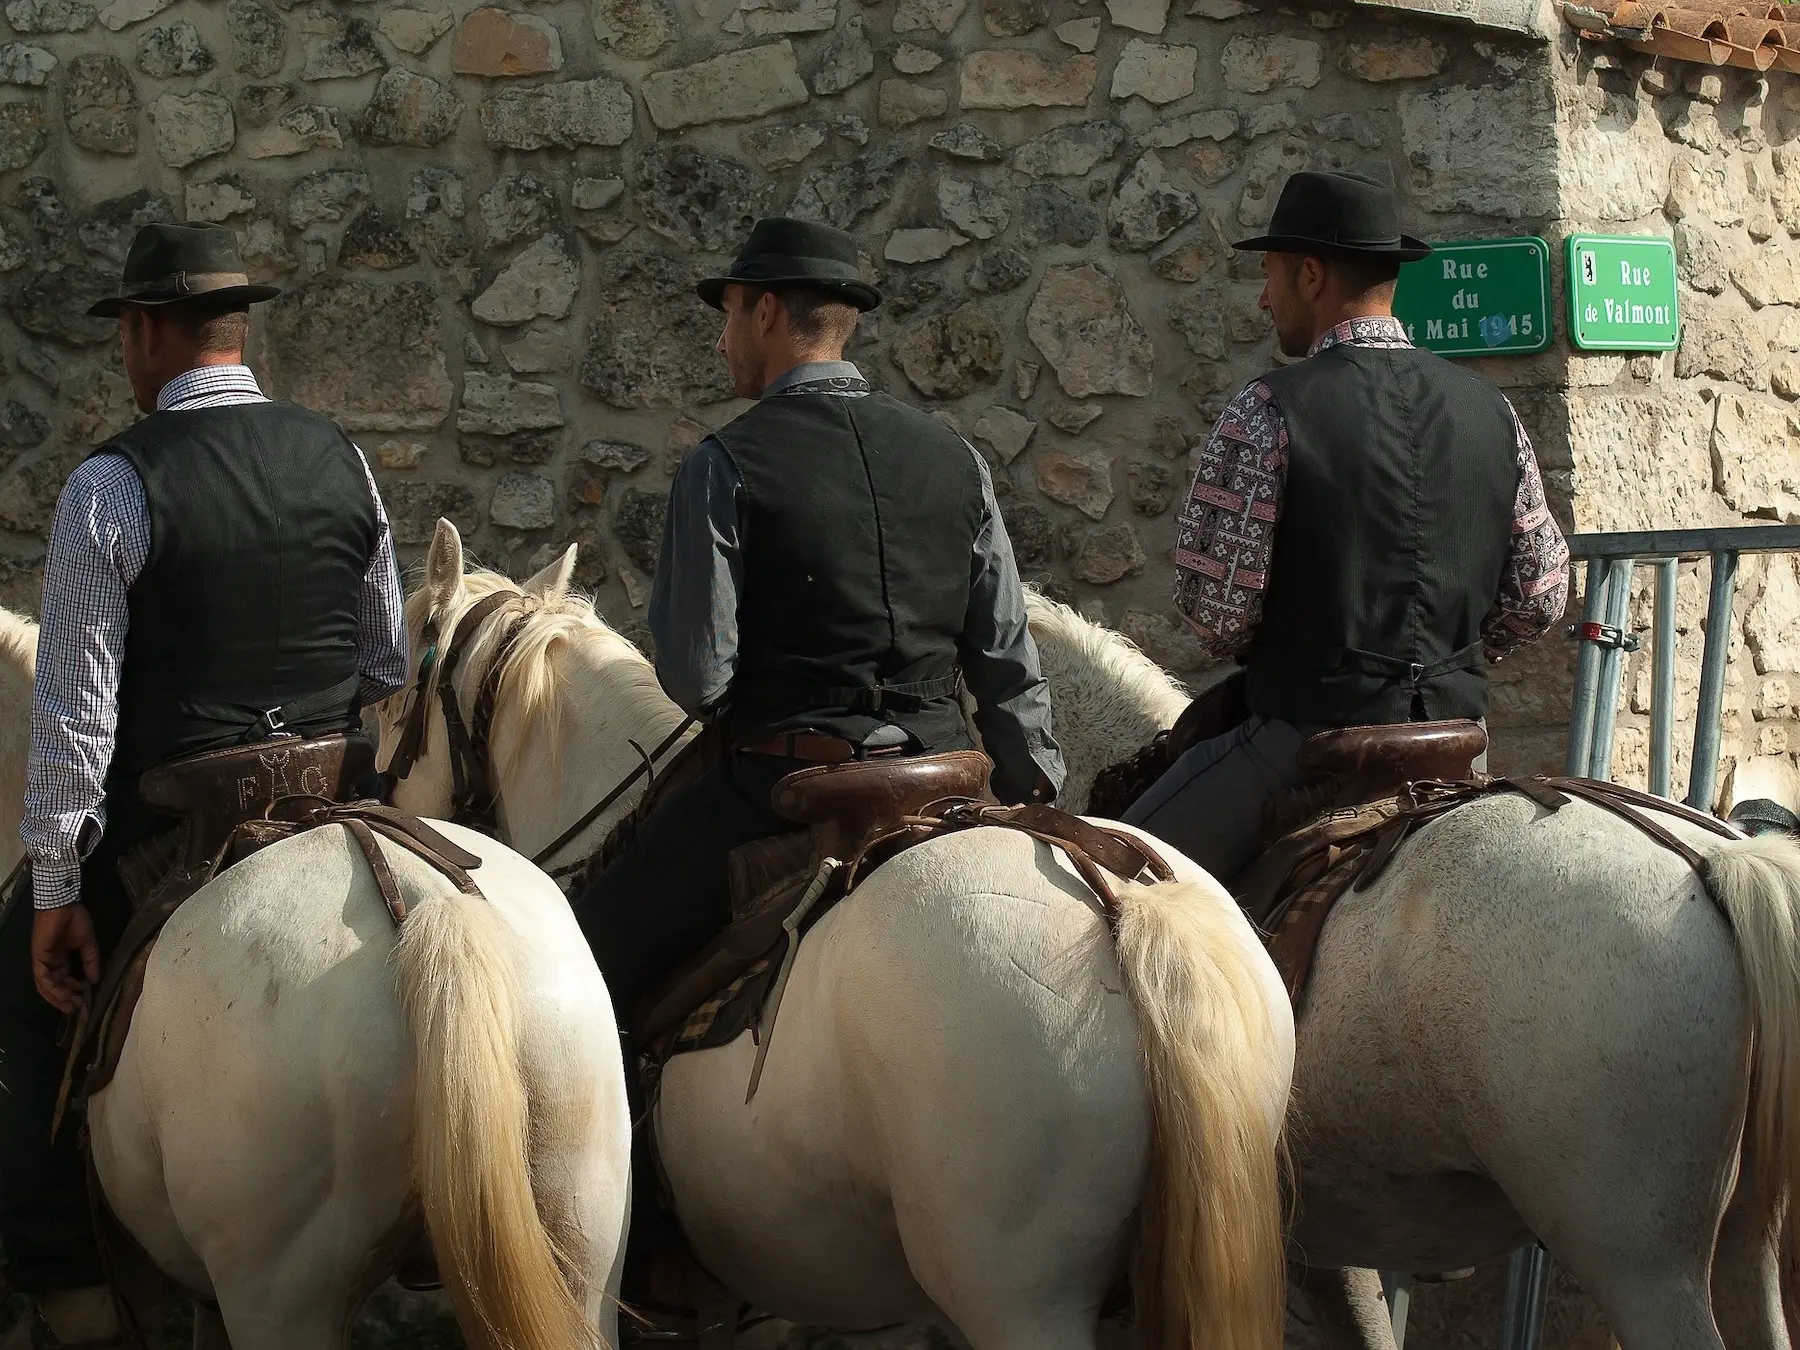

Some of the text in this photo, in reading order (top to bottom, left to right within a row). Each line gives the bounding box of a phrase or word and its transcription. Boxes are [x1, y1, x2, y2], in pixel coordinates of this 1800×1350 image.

[1442, 259, 1488, 280] Rue
[1620, 260, 1651, 286] Rue
[1452, 289, 1480, 309] du
[1584, 298, 1670, 325] de Valmont
[1426, 318, 1468, 340] Mai
[1479, 313, 1533, 337] 1945
